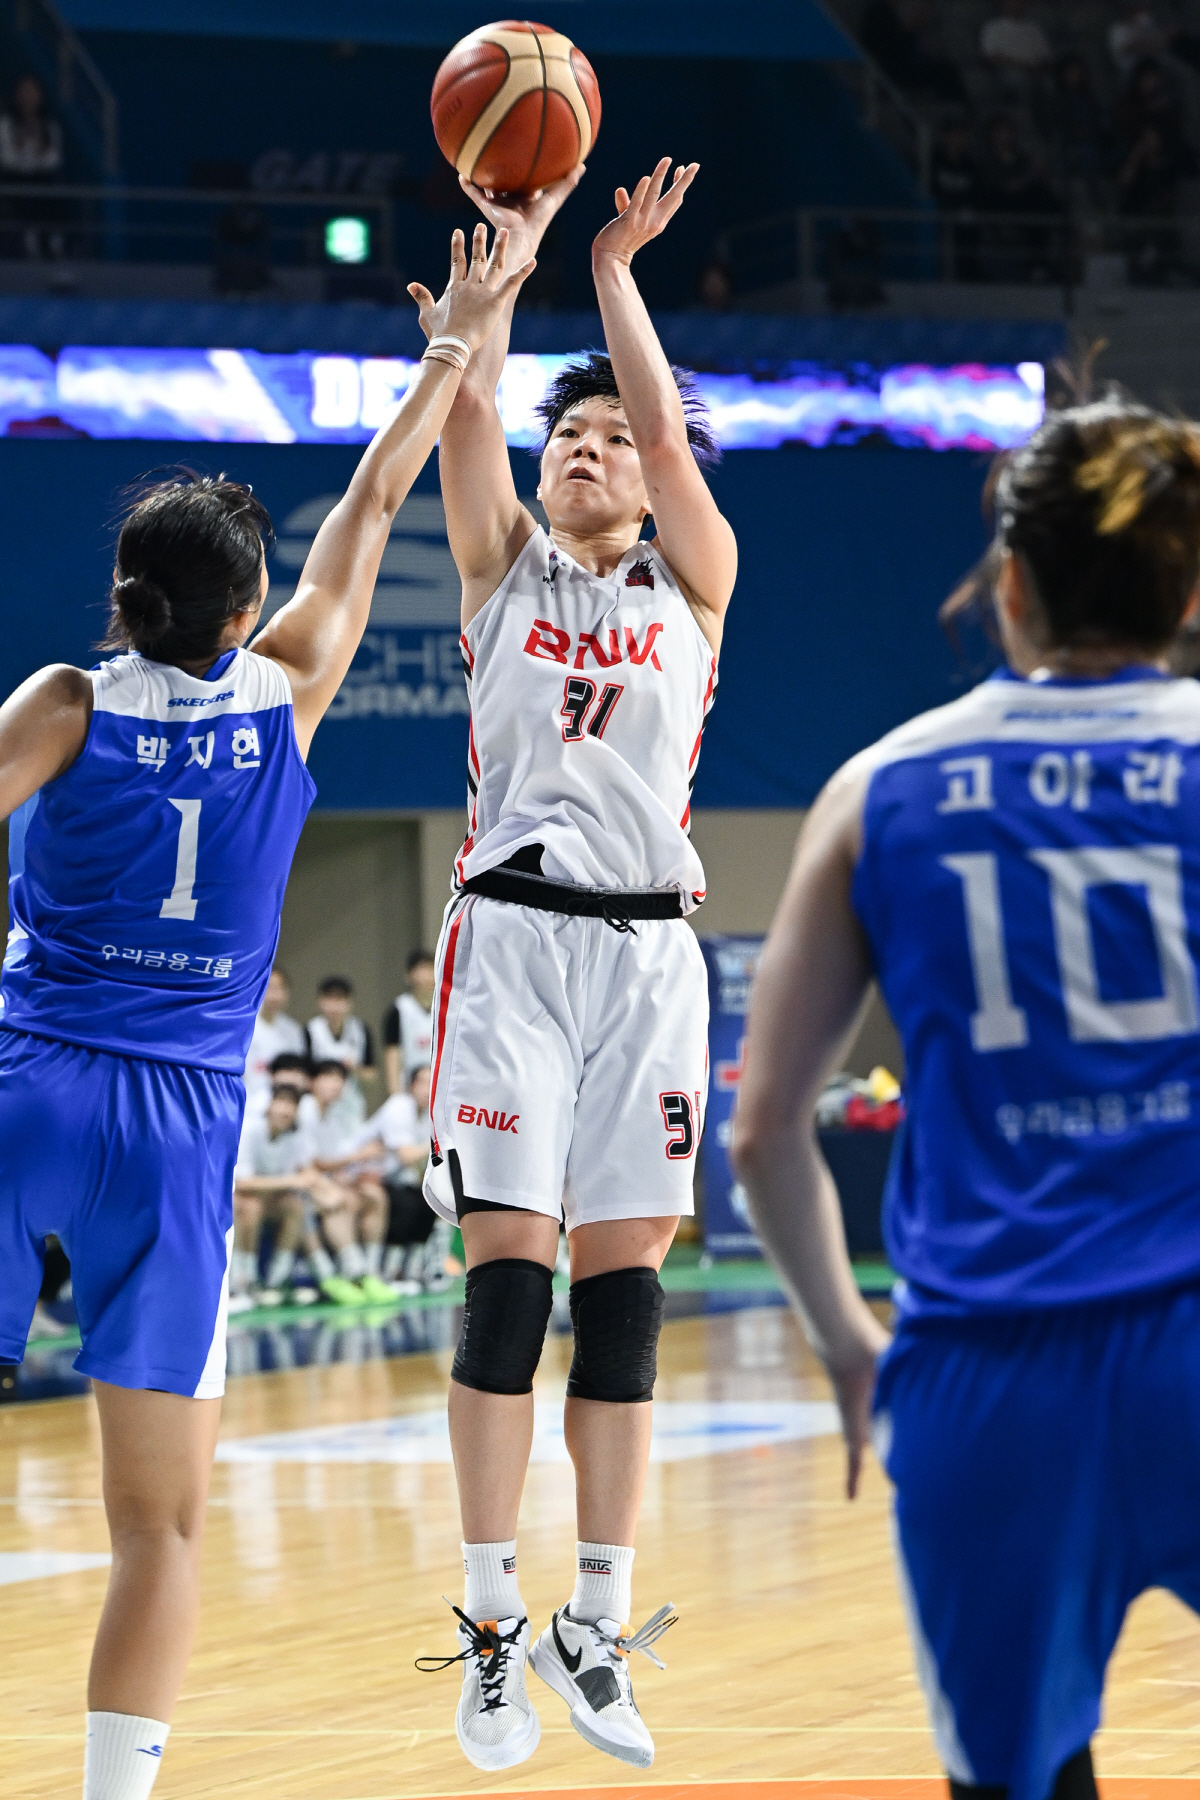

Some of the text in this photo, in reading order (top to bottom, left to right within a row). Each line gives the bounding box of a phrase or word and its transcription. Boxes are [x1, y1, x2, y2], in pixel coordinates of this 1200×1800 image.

[523, 618, 664, 672] BNK
[560, 675, 625, 743] 31
[159, 797, 202, 921] 1
[101, 944, 233, 979] 우리금융그룹
[938, 844, 1200, 1054] 10
[457, 1103, 520, 1134] BNK
[579, 1561, 612, 1571] BNK
